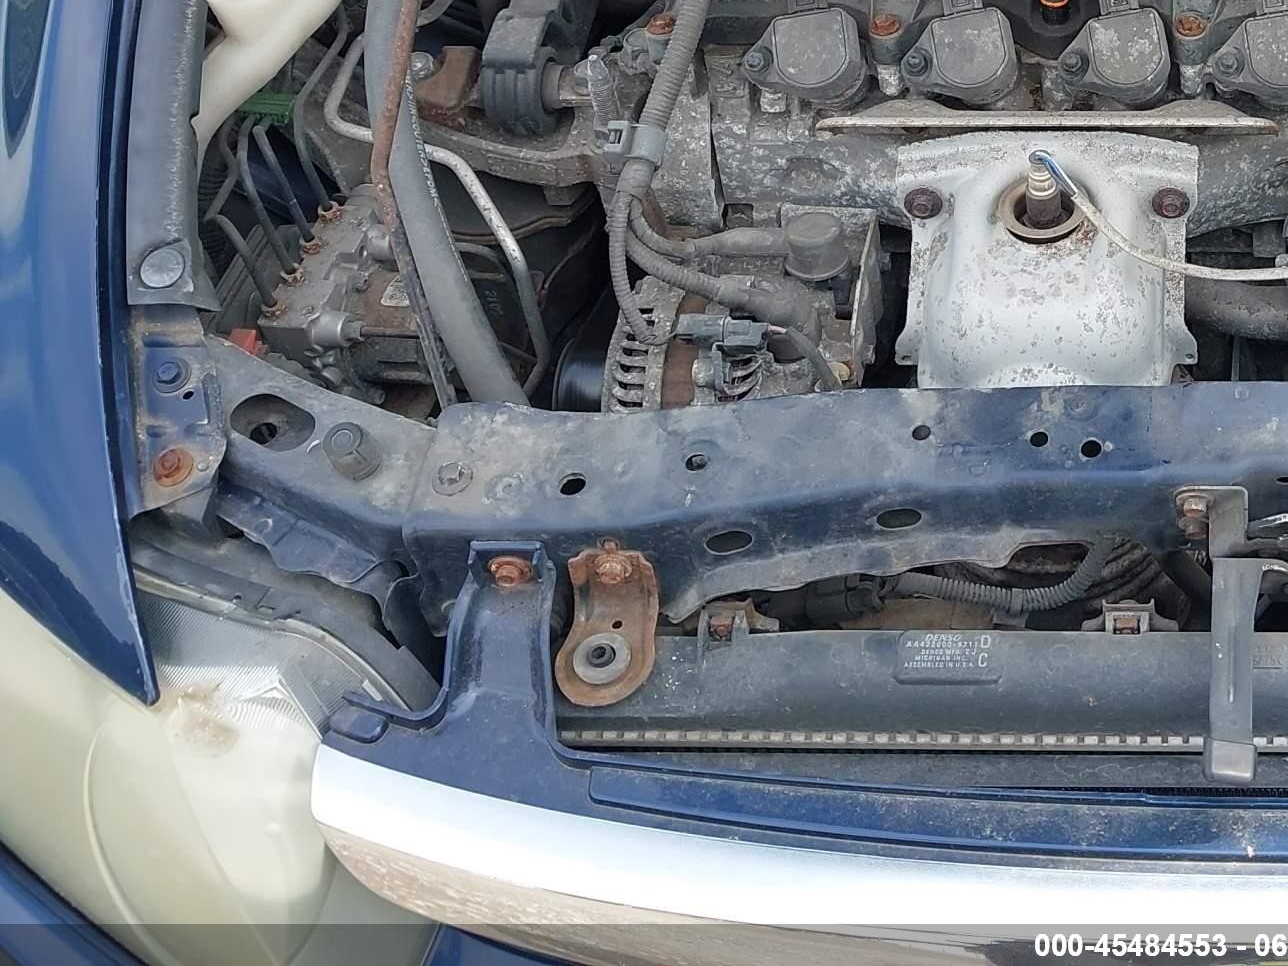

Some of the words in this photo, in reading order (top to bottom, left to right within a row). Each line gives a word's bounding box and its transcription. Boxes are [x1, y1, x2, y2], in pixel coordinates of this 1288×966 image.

[924, 633, 962, 642] DENSO
[980, 634, 992, 649] D
[978, 652, 989, 668] C
